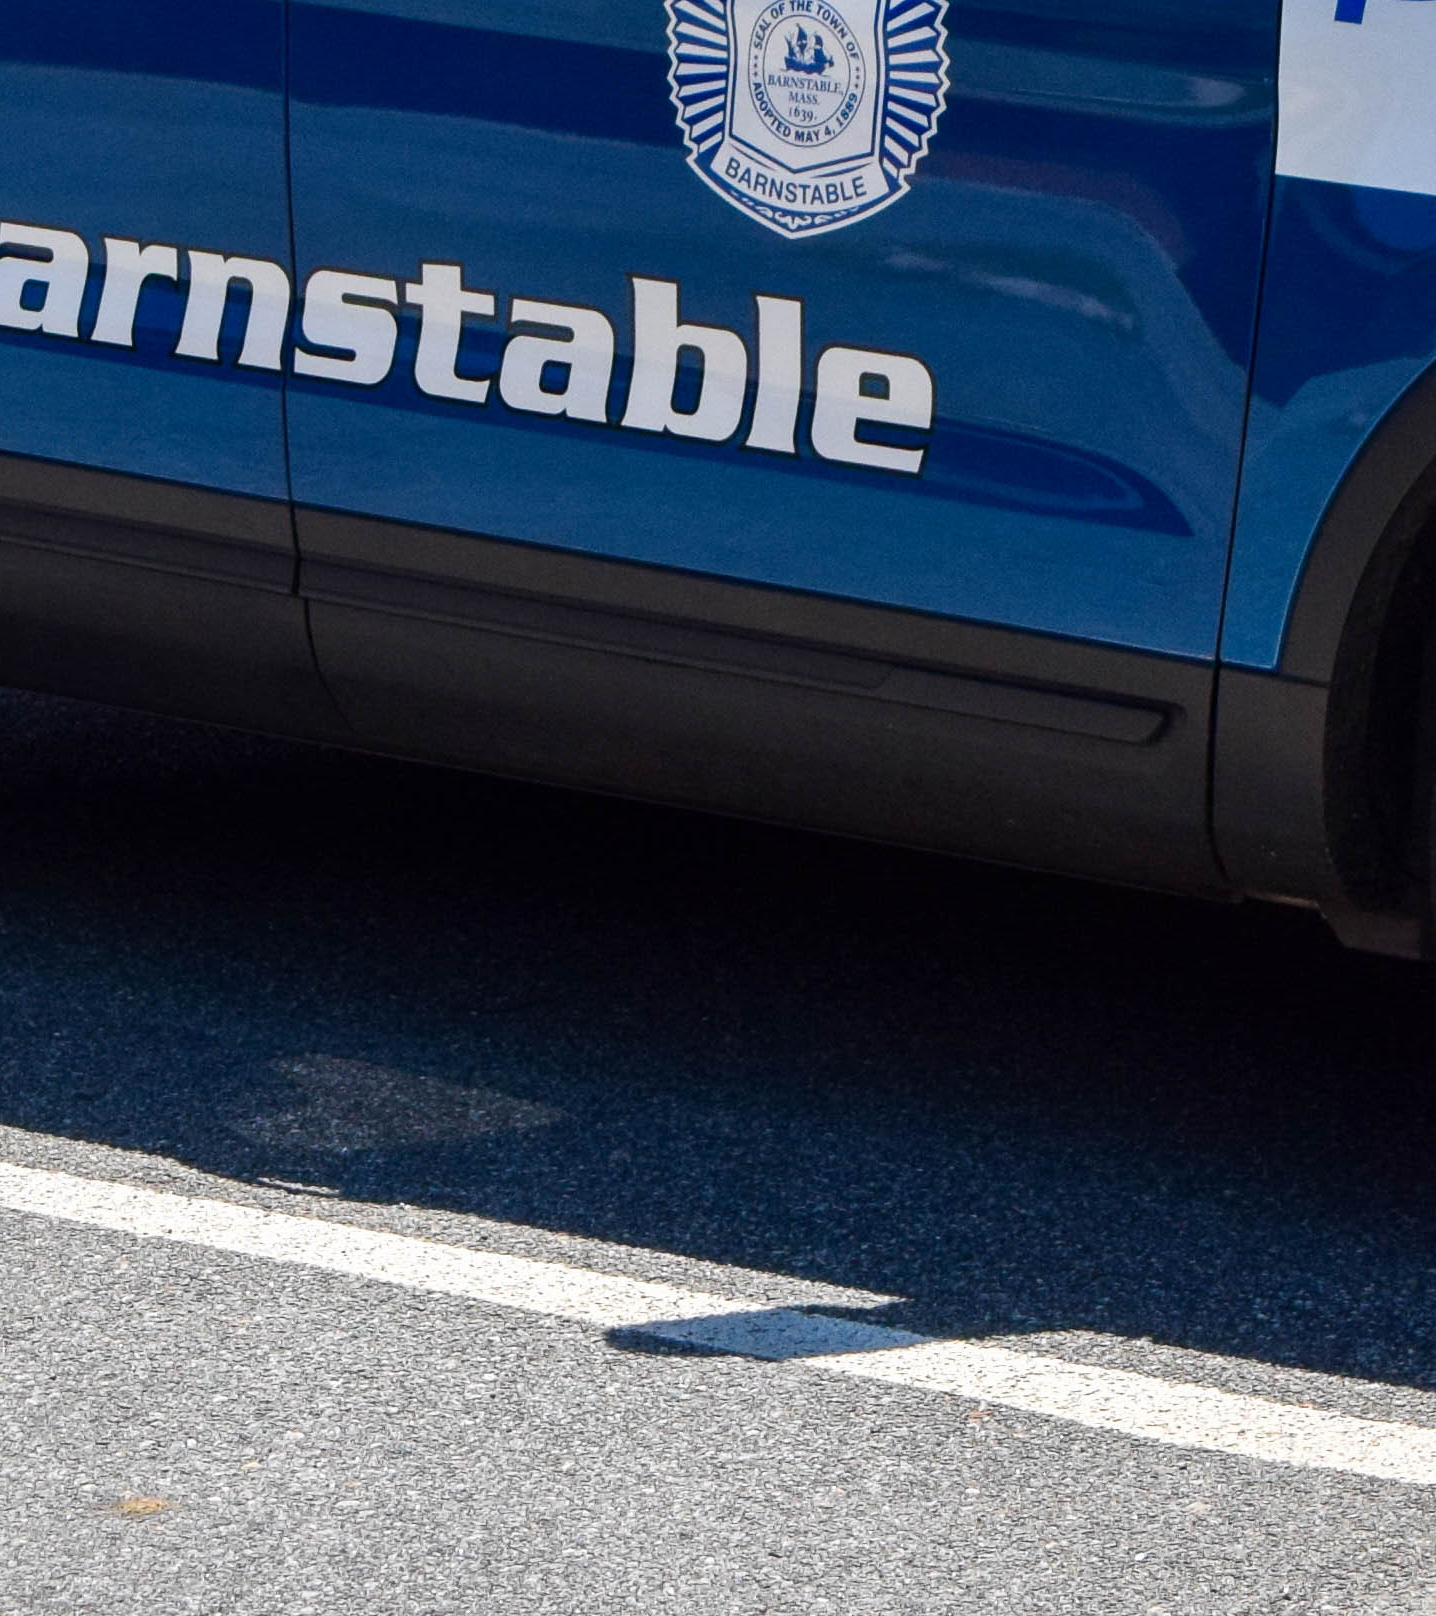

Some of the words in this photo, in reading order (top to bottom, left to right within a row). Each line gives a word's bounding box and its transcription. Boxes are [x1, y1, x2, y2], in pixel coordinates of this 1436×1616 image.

[754, 21, 771, 50] SEAL
[770, 2, 785, 19] OF
[789, 0, 813, 13] THE
[816, 4, 848, 39] TOWN
[846, 41, 859, 60] OF
[753, 82, 791, 137] ADOPTED
[794, 129, 820, 143] MAY
[835, 92, 857, 128] 1889
[724, 155, 868, 207] BARNSTABLE
